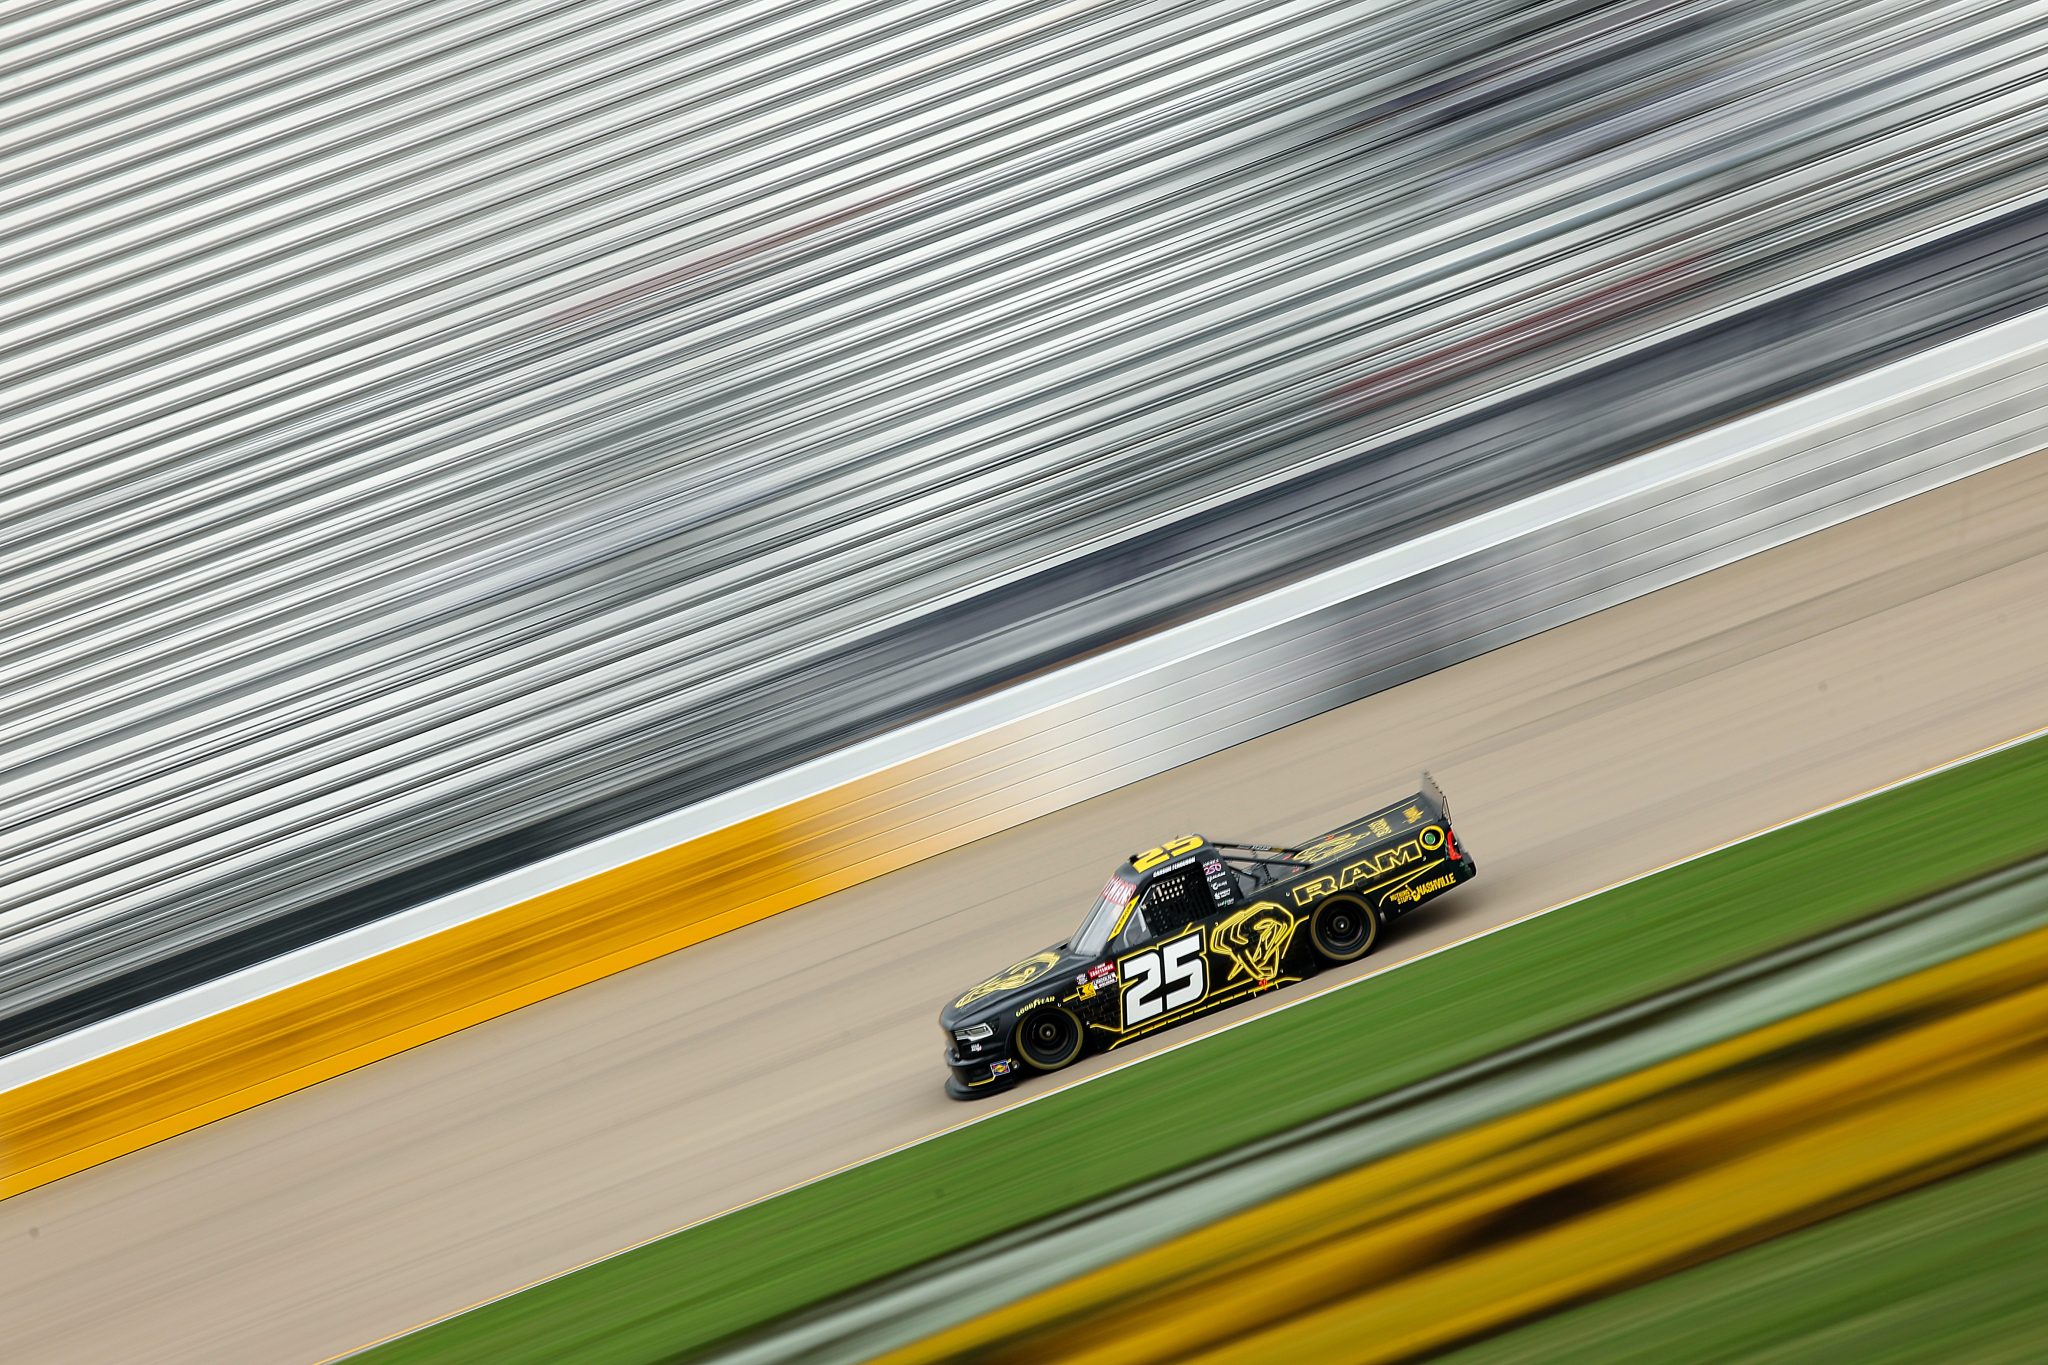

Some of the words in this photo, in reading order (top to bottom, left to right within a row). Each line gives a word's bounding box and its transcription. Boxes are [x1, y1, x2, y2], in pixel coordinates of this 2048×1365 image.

[1132, 835, 1204, 874] 25
[1292, 840, 1422, 906] RAM
[1415, 872, 1457, 896] NASHVILLE
[1123, 933, 1204, 1026] 25
[1015, 996, 1056, 1017] GOODYEAR
